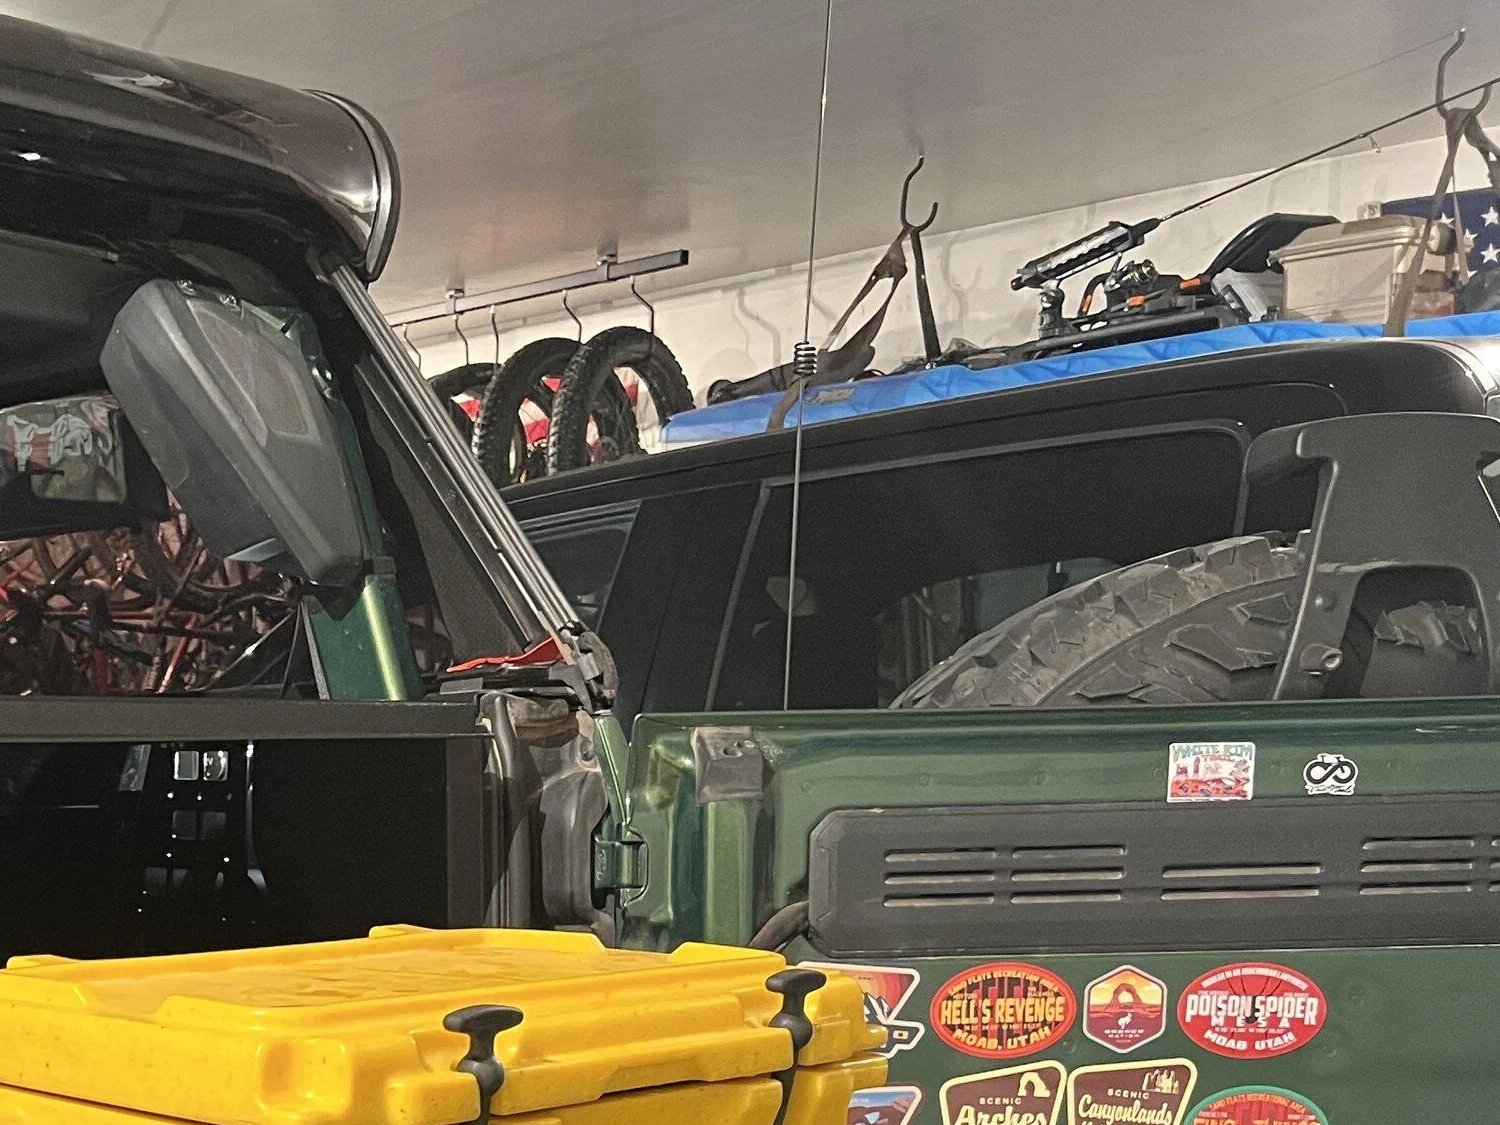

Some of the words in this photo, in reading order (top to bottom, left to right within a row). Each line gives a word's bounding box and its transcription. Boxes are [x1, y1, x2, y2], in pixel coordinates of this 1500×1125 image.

[995, 996, 1066, 1024] REVENGE
[1185, 994, 1252, 1023] POISON
[1255, 995, 1319, 1025] SPIDER
[1211, 1014, 1290, 1028] MESA
[1007, 1026, 1052, 1049] UTAH
[1203, 1029, 1247, 1050] MOAB
[1255, 1031, 1296, 1050] UTAH
[979, 1097, 1022, 1105] SCENIC
[1107, 1088, 1150, 1100] SCENIC
[1078, 1094, 1173, 1125] Canyonlands
